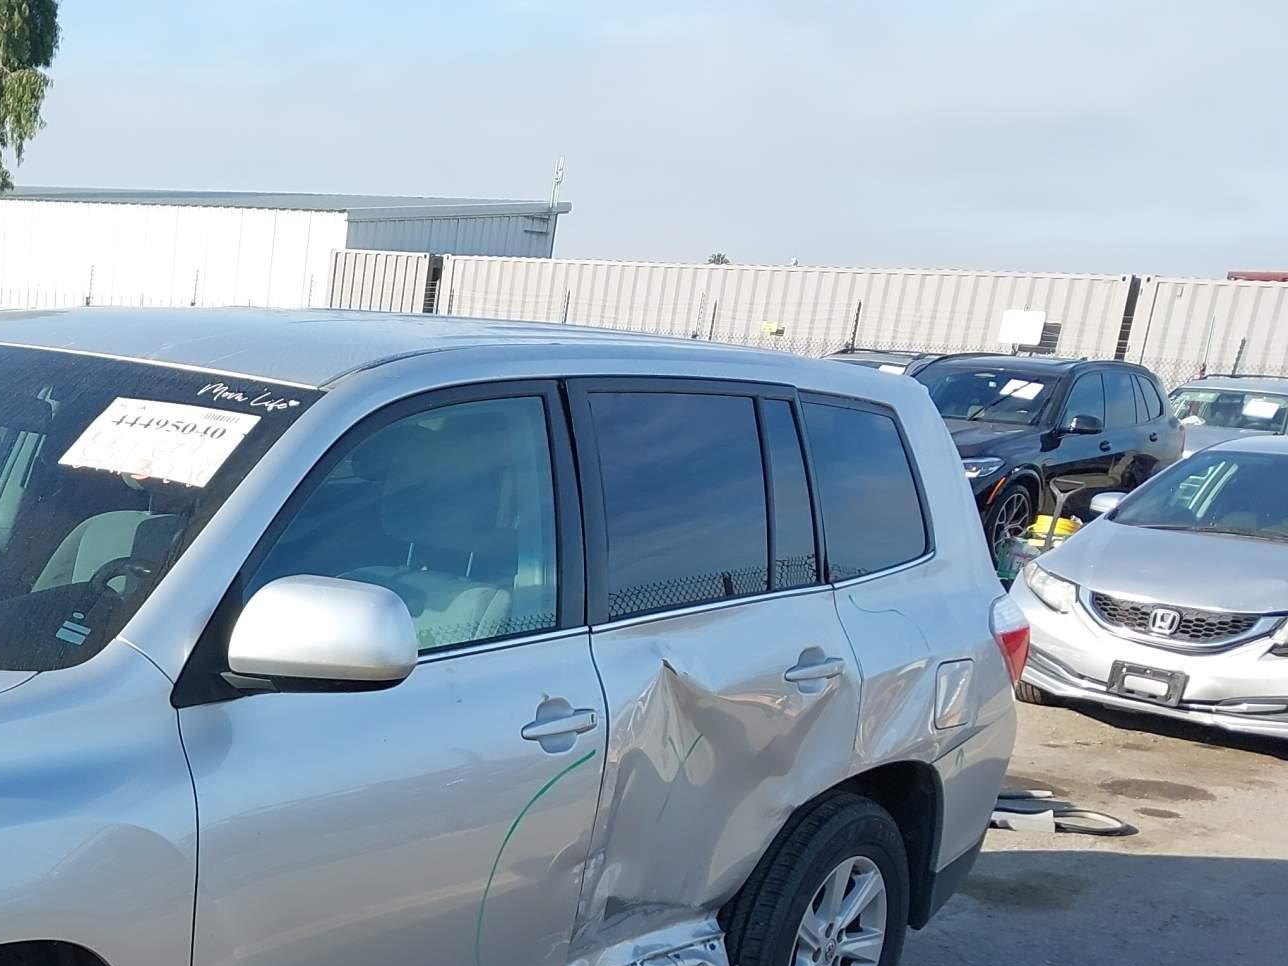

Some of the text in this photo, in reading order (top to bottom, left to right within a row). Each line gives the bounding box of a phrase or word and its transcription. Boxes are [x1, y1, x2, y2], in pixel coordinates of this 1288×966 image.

[197, 383, 289, 411] Mom Life
[112, 413, 226, 439] 44495040
